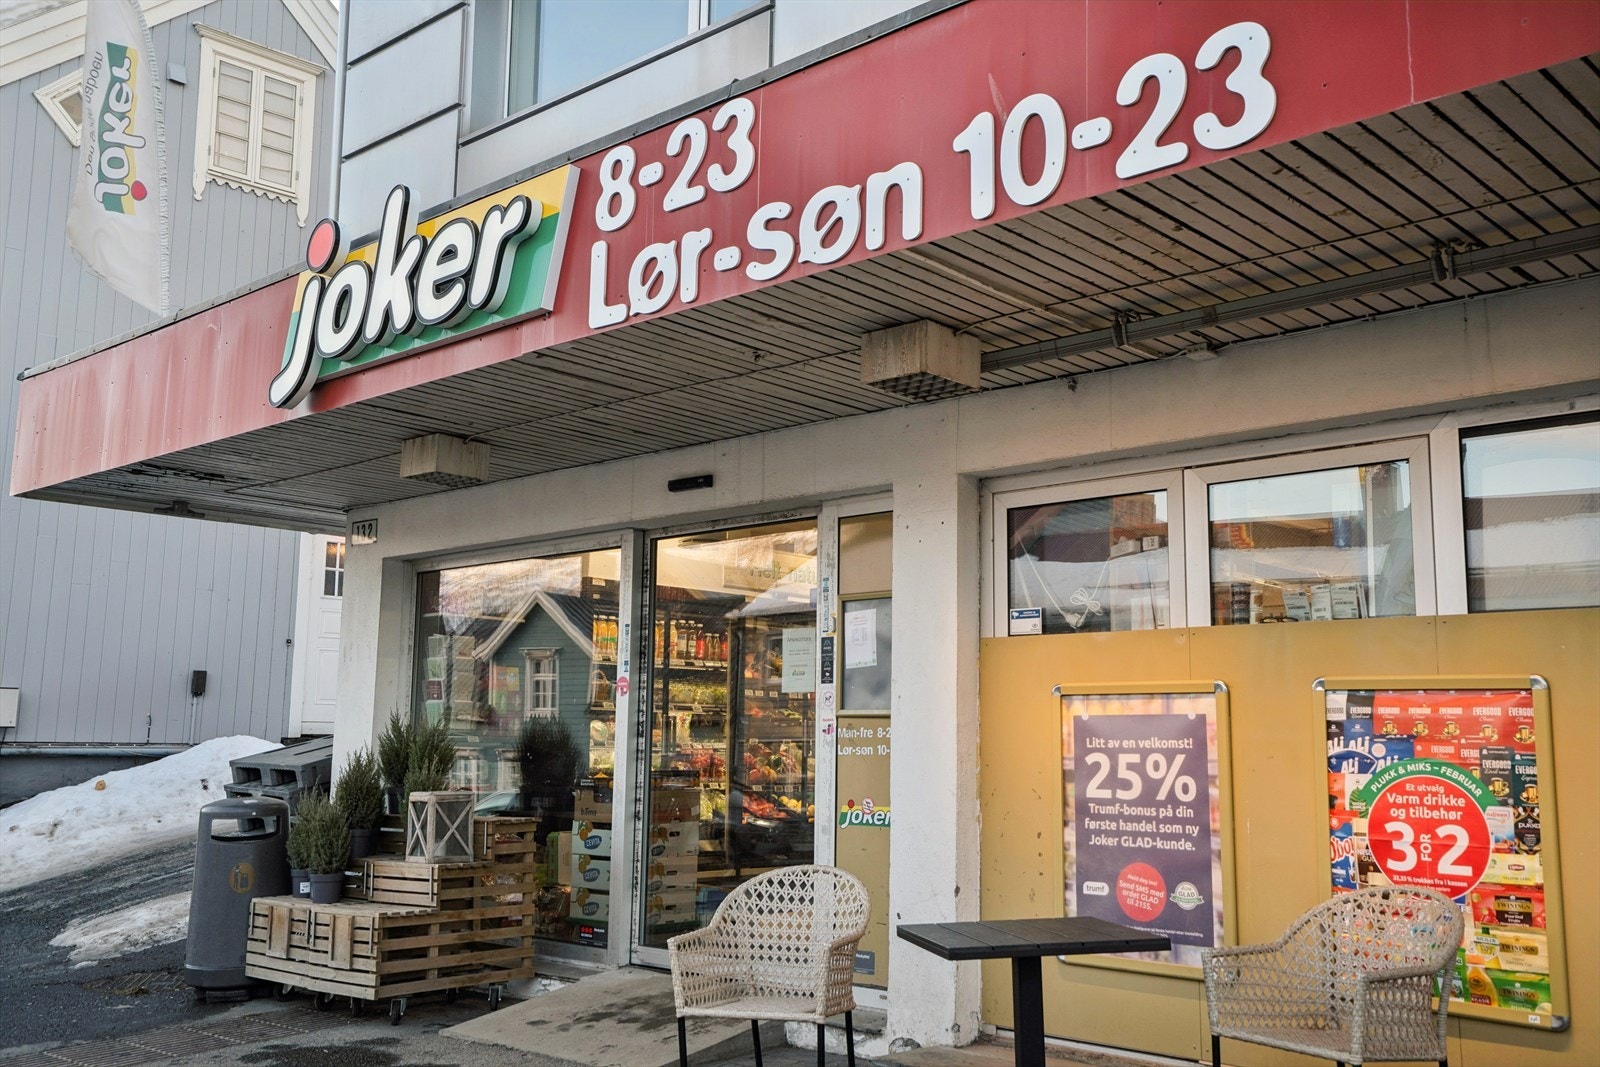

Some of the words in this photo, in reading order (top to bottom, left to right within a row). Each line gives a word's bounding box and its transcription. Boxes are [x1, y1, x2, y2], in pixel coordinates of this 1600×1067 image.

[595, 97, 756, 232] 8-23
[588, 161, 924, 329] Lør-søn
[952, 21, 1277, 221] 10-23
[268, 184, 534, 409] joker
[356, 523, 373, 539] 132
[1350, 706, 1372, 714] EVERGOOD
[1377, 706, 1401, 714] EVERGOOD
[1408, 706, 1432, 714] EVERGOOD
[1439, 706, 1463, 715] EVERGOOD
[1473, 706, 1502, 716] EVERGOOD
[838, 727, 874, 738] Man-fre
[1086, 736, 1106, 748] Litt
[1107, 738, 1120, 748] av
[1122, 739, 1136, 748] en
[1138, 736, 1193, 749] velkomst!
[838, 743, 874, 755] Lør-søn
[1430, 745, 1455, 754] EVERGOOD
[1482, 760, 1511, 770] EVERGOOD
[1084, 752, 1197, 802] 25%
[1370, 769, 1398, 792] PLUKK
[1398, 766, 1406, 775] &
[1406, 762, 1431, 773] MIKS
[1440, 766, 1483, 797] FEBRUAR
[1405, 783, 1416, 791] Et
[1417, 784, 1445, 793] utvalg
[1386, 792, 1417, 805] Varm
[1423, 793, 1466, 807] drikke
[1088, 803, 1157, 816] Trumf-bonus
[1159, 805, 1174, 819] på
[1176, 805, 1194, 818] din
[1390, 808, 1406, 820] og
[1409, 807, 1463, 820] tilbehør
[1084, 818, 1117, 831] første
[1119, 819, 1157, 832] handel
[1159, 824, 1183, 834] som
[1185, 825, 1200, 837] ny
[1089, 834, 1119, 846] Joker
[1121, 836, 1196, 851] GLAD-kunde.
[1384, 821, 1418, 872] 3
[1420, 833, 1432, 862] FOR
[1435, 823, 1473, 877] 2
[1434, 878, 1444, 886] fra
[1447, 879, 1468, 887] kassen
[1119, 880, 1135, 891] Send
[1135, 883, 1150, 894] SMS
[1149, 889, 1164, 899] med
[1178, 890, 1195, 899] GLAD
[1121, 889, 1140, 901] ordet
[1140, 893, 1159, 905] GLAD
[1126, 897, 1134, 906] til
[1496, 902, 1531, 911] TWININGS
[1501, 943, 1535, 953] TWININGS
